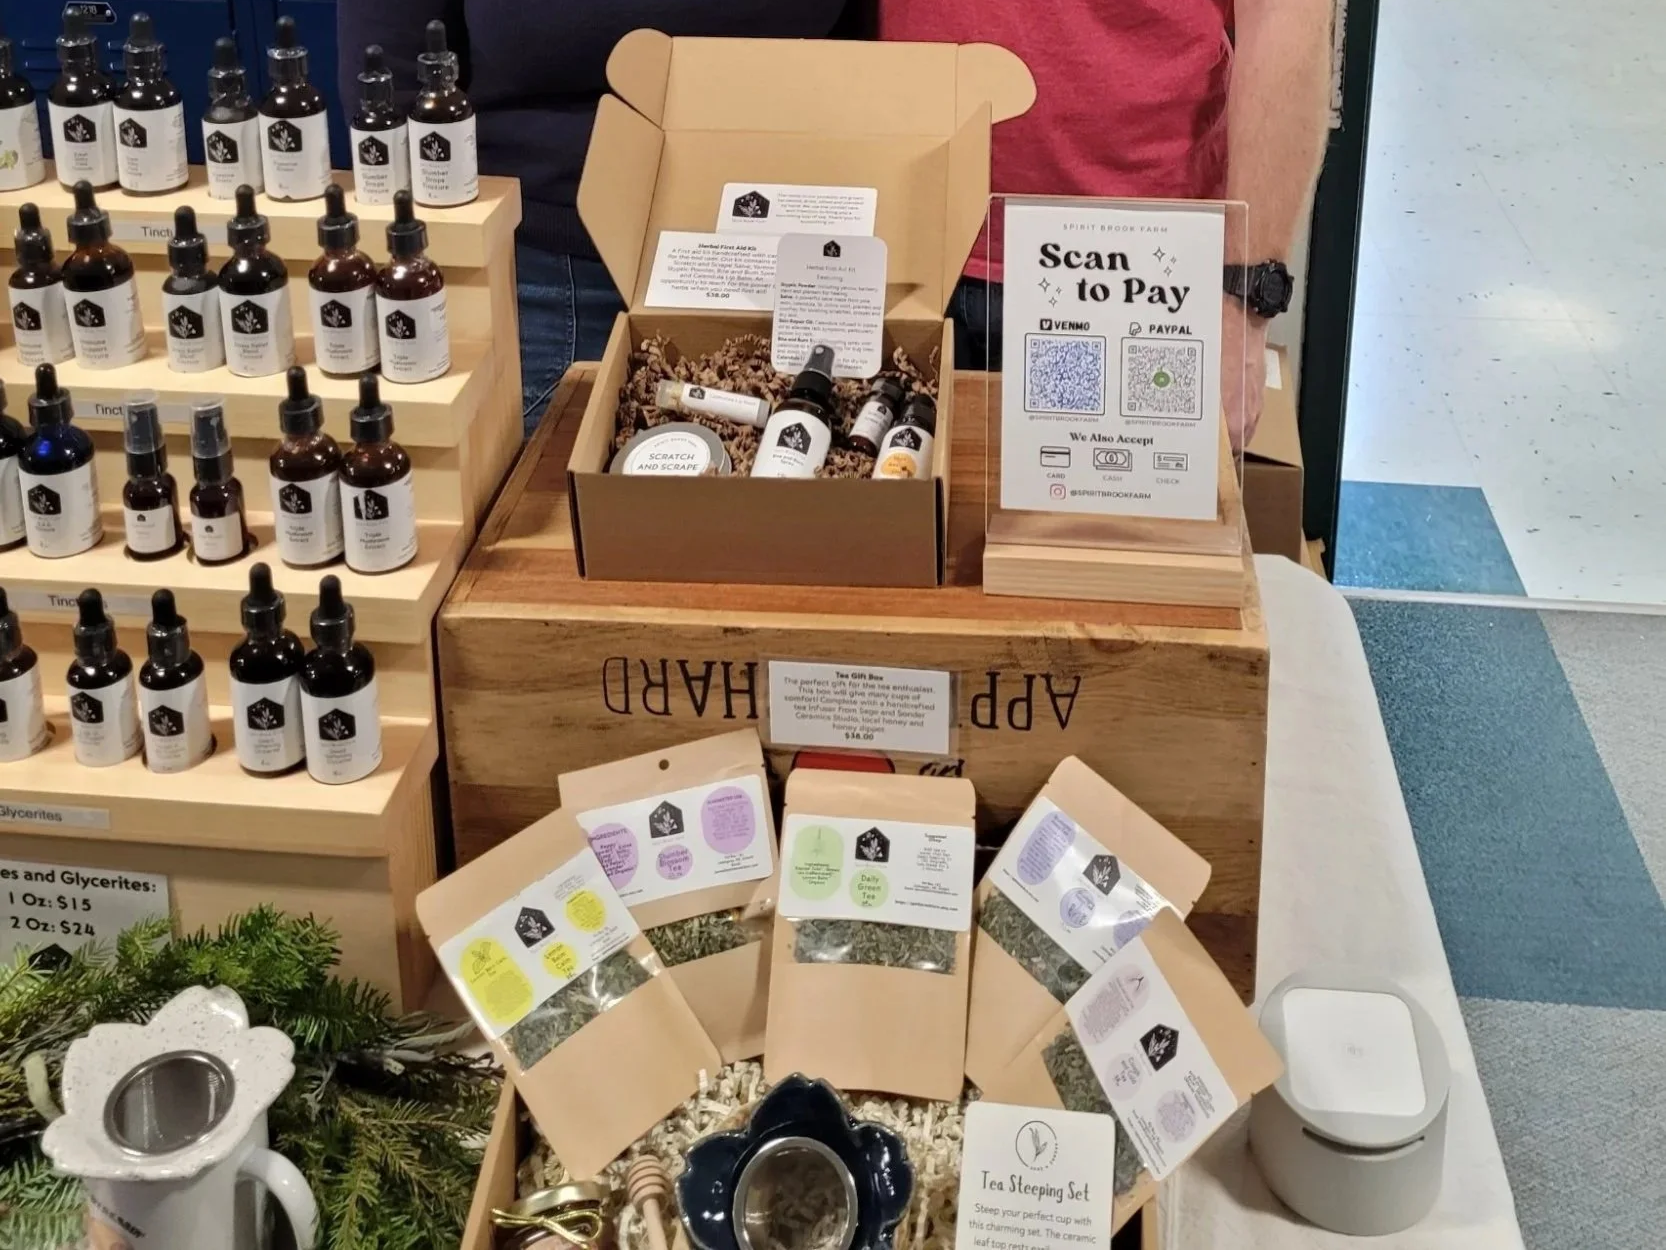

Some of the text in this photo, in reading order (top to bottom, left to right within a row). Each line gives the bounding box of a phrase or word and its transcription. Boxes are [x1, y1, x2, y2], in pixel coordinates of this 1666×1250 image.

[1063, 223, 1096, 231] SPIRIT
[1100, 225, 1135, 233] BROOK
[1038, 242, 1131, 271] Scan
[1077, 277, 1191, 314] to Pay
[1054, 320, 1090, 331] VENMO
[1149, 324, 1193, 335] PAYPAL
[1069, 432, 1154, 446] We Also Accept
[649, 453, 695, 461] SCRATCH
[636, 463, 699, 471] AND SCRAPE
[1156, 477, 1180, 485] CHECK
[1070, 489, 1152, 500] @SPIRITBROOKFARM
[784, 677, 798, 685] The
[800, 678, 829, 687] perfect
[831, 679, 846, 688] gift
[848, 680, 860, 688] for
[835, 671, 884, 681] Tea Gift Box
[602, 657, 759, 719] HARD
[798, 686, 814, 694] This
[816, 687, 831, 695] box
[833, 688, 847, 696] will
[849, 689, 866, 699] give
[868, 691, 889, 700] many
[891, 693, 910, 702] cups
[820, 695, 858, 706] Complete
[886, 700, 935, 711] handcrafted
[969, 671, 1081, 731] APP
[795, 712, 831, 721] Ceramics
[861, 715, 881, 724] local
[882, 717, 907, 727] honey
[909, 719, 924, 727] and
[23, 870, 56, 883] and
[60, 871, 157, 893] Glycerites:
[857, 882, 881, 891] Green
[861, 874, 880, 884] Daily
[9, 891, 92, 912] 1 Oz: $15
[862, 891, 876, 900] Tea
[10, 916, 95, 936] 2 Oz: $24
[981, 1170, 1090, 1203] Tea Steeping Set
[974, 1203, 1092, 1226] Steep your perfect cup with
[969, 1219, 1096, 1244] this charming set. The ceramic
[974, 1235, 990, 1247] leaf
[992, 1239, 1007, 1250] top
